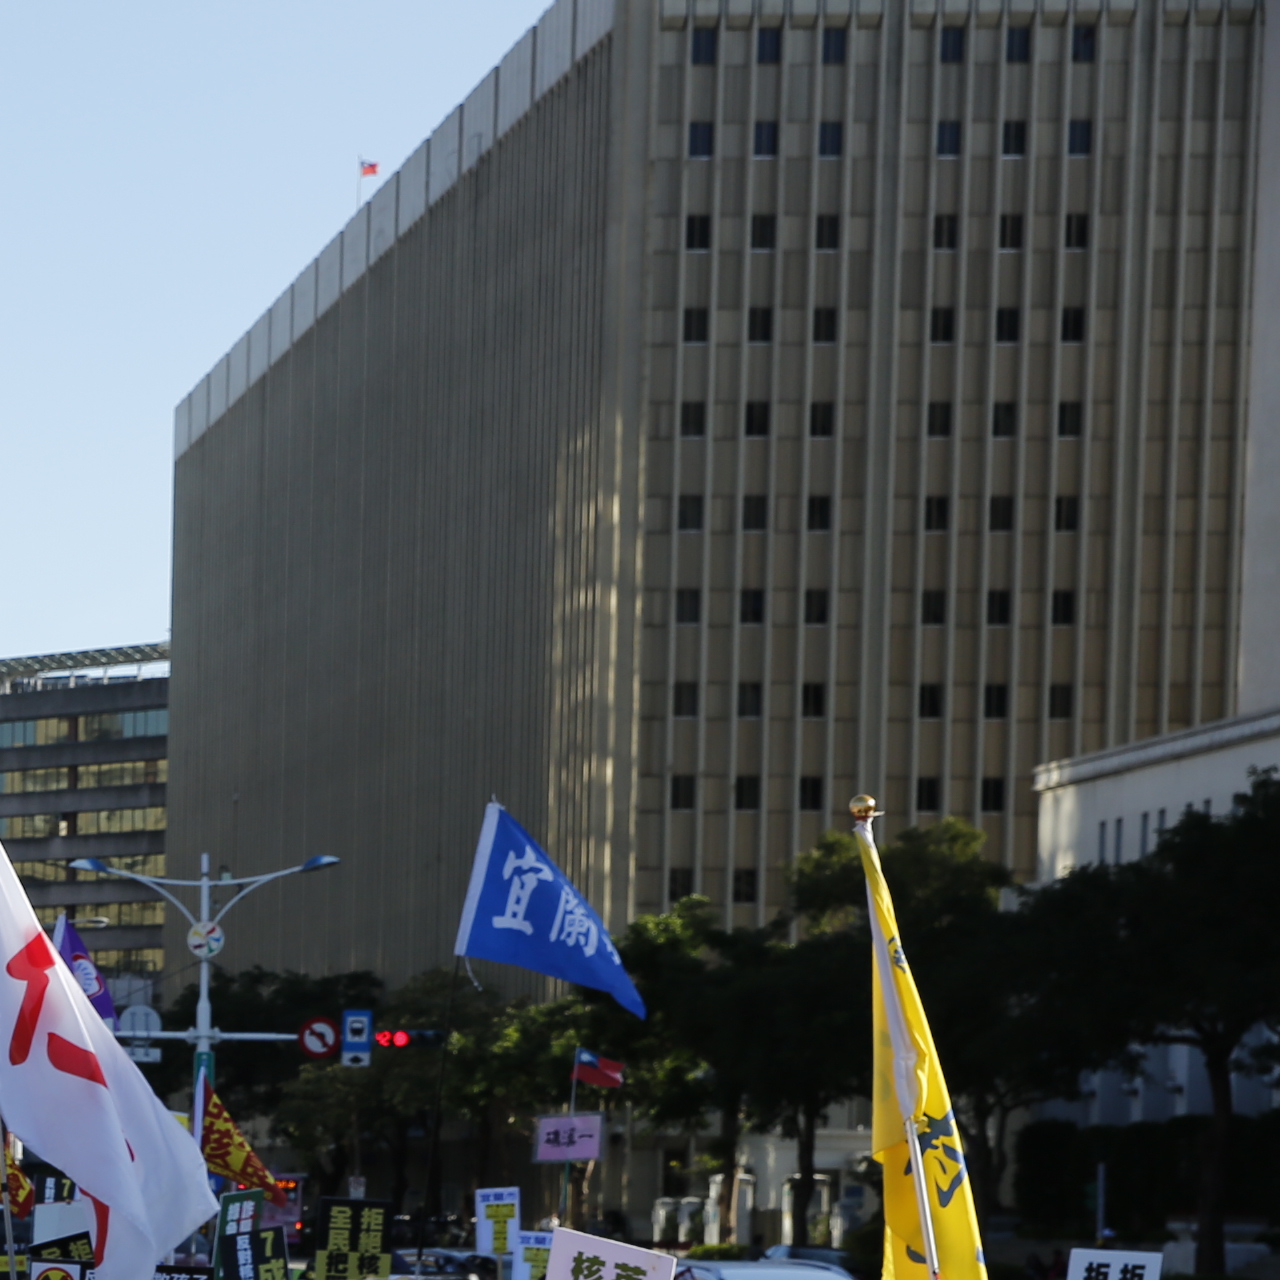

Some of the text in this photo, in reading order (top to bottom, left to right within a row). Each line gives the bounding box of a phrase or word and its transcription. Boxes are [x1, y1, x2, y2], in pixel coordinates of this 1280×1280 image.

[61, 1179, 72, 1199] 7
[326, 1206, 352, 1280] 全民把
[357, 1207, 385, 1275] 拒絕核
